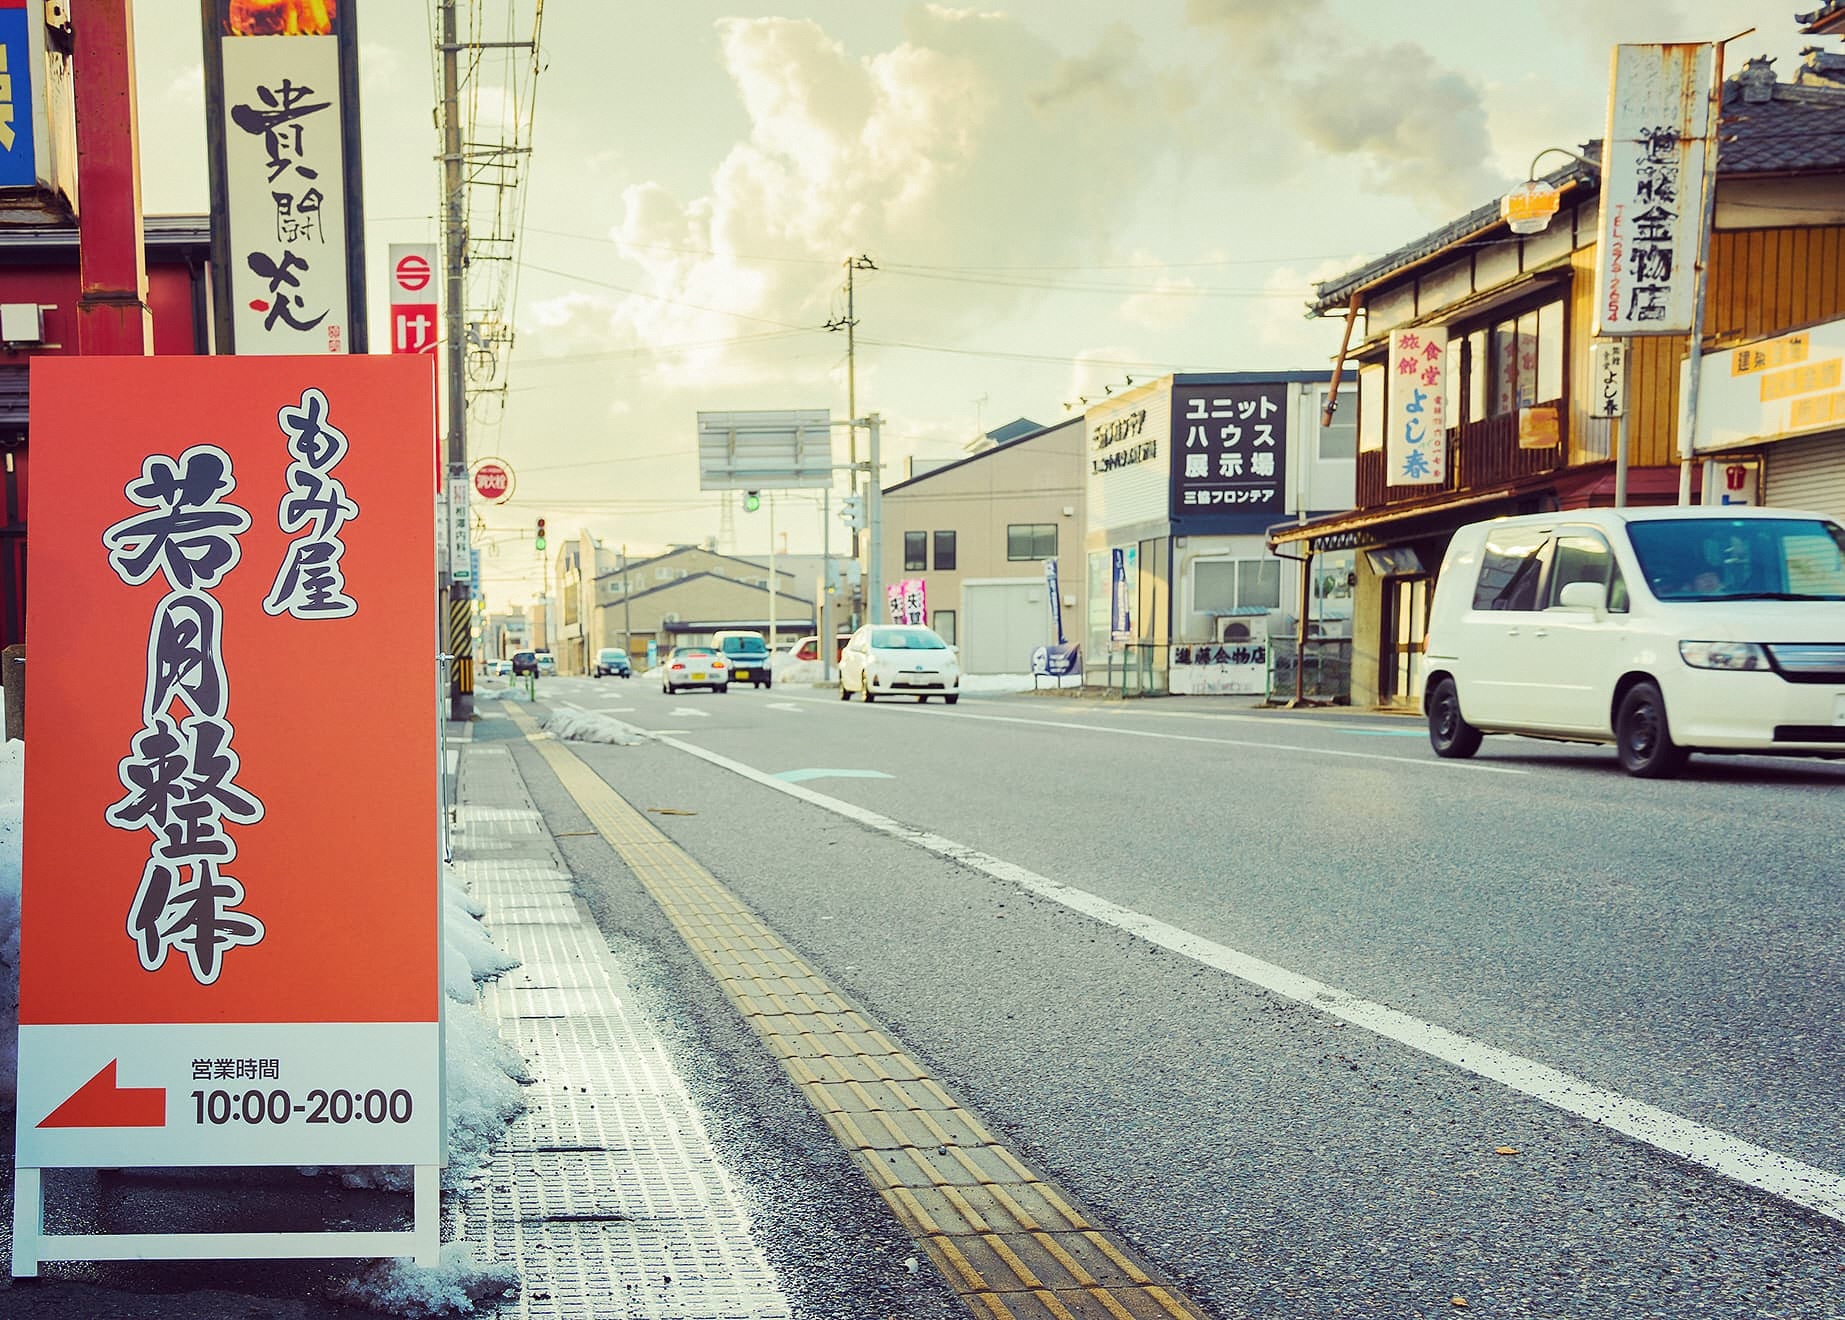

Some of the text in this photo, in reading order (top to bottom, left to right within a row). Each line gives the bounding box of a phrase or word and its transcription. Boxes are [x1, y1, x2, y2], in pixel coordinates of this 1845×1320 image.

[1398, 333, 1421, 376] 旅館
[1421, 341, 1443, 387] 食堂
[1186, 395, 1278, 419] ユニット
[1186, 424, 1276, 448] ハウス
[1402, 388, 1430, 480] よし春
[1185, 452, 1275, 478] 展示場
[263, 389, 358, 618] もみ屋
[105, 446, 264, 984] 若月整体
[192, 1058, 280, 1081] 営業時間
[190, 1088, 414, 1125] 10:00-20:00
